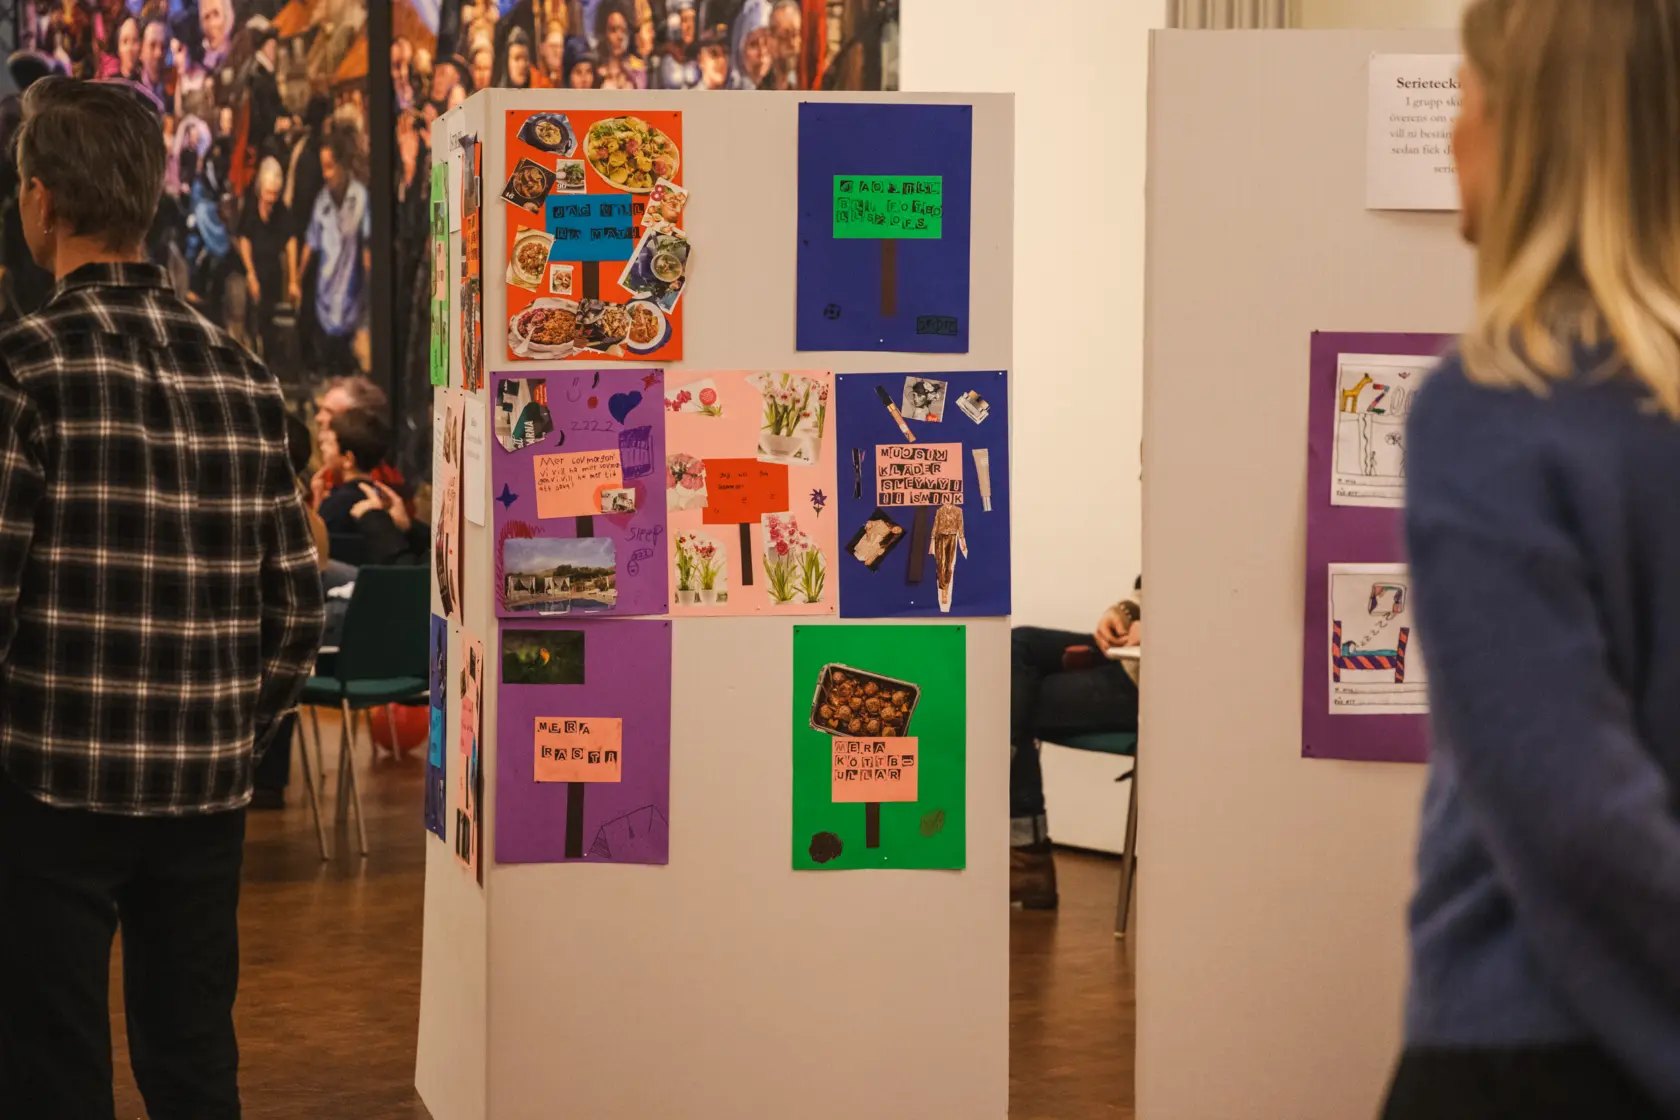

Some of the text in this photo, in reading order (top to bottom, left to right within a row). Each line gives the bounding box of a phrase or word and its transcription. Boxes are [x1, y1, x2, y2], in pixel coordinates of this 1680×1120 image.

[1413, 98, 1443, 109] grupp
[1389, 113, 1427, 123] överens
[1430, 115, 1447, 123] om
[1389, 128, 1405, 138] vill
[1408, 129, 1417, 138] ni
[1391, 144, 1419, 154] sedan
[1423, 144, 1440, 154] fick
[553, 203, 644, 218] JAG VILL
[540, 457, 564, 467] Mer
[537, 721, 590, 735] MERA
[835, 741, 886, 754] MERA
[835, 769, 902, 781] ULLAR
